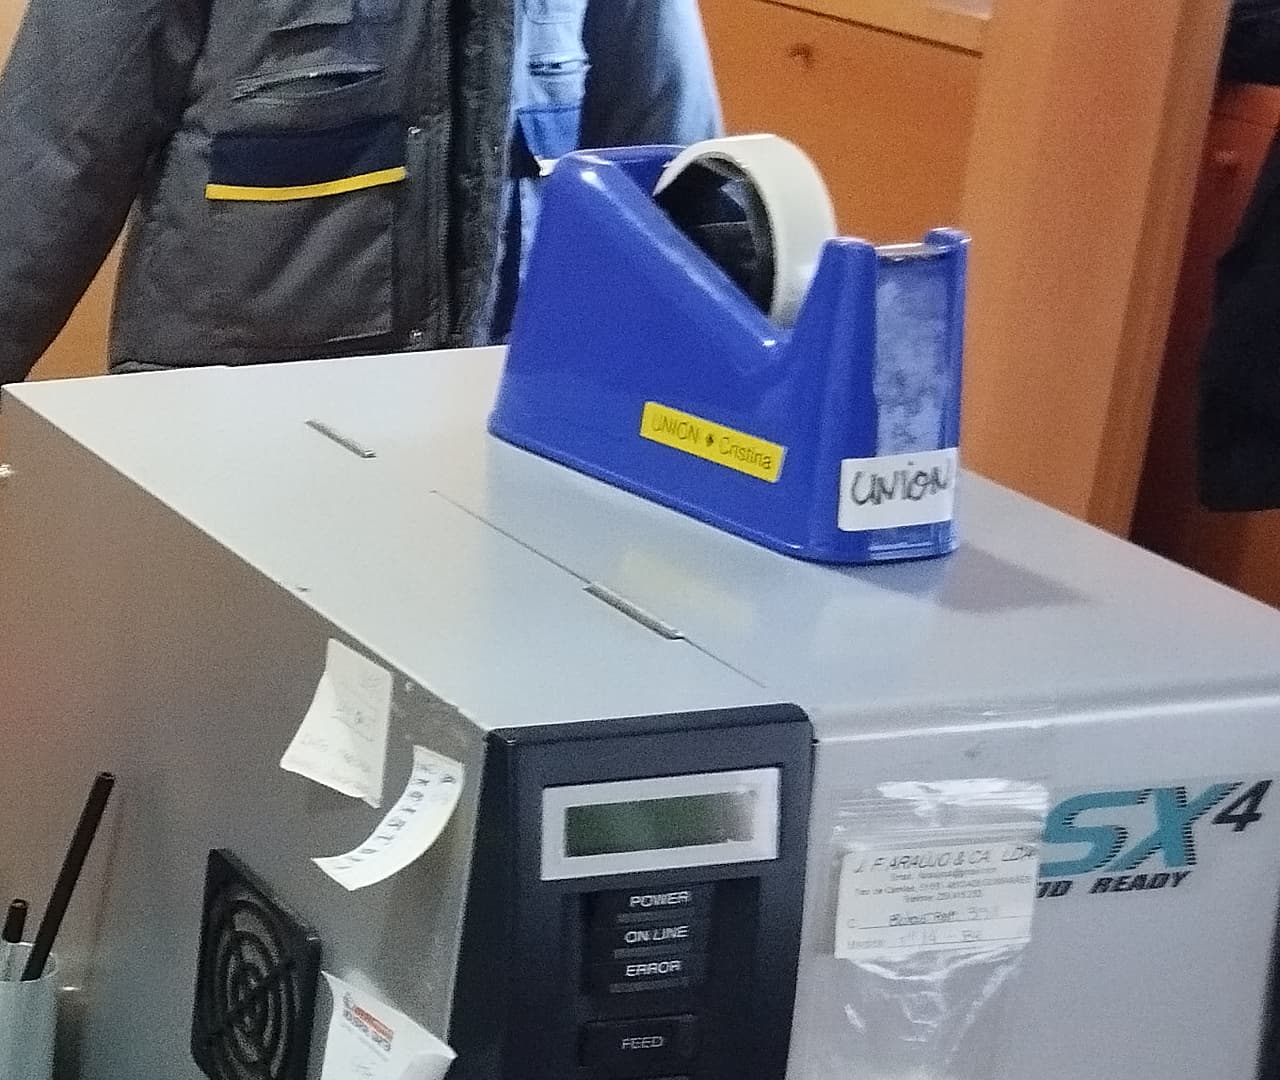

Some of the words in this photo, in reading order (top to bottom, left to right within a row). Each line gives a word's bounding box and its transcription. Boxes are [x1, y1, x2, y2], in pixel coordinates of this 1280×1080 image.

[652, 413, 701, 446] UNION
[719, 436, 773, 471] Cristina
[1089, 870, 1193, 894] READY
[629, 891, 693, 908] POWER
[624, 928, 651, 943] ON
[652, 925, 689, 941] LINE
[625, 960, 681, 977] ERROR
[621, 1035, 664, 1051] FEED
